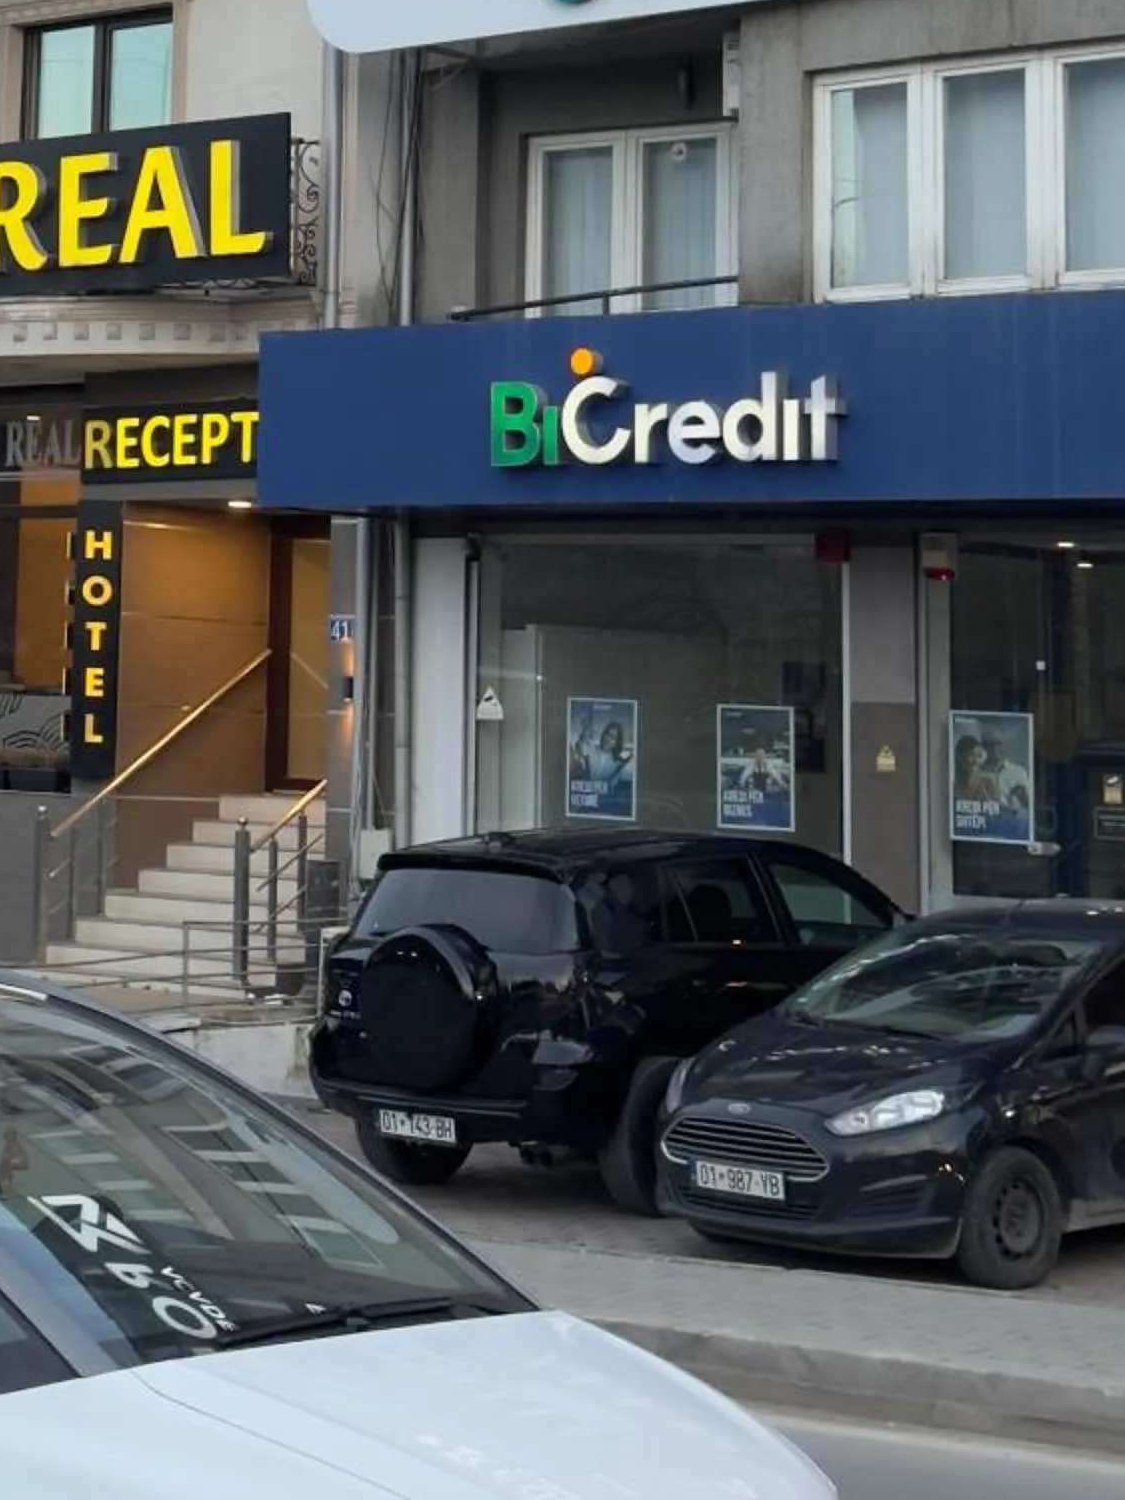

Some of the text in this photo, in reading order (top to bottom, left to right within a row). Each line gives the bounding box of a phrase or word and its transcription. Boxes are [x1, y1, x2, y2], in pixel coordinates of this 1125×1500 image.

[5, 408, 81, 468] REAL
[490, 348, 847, 466] BiCredit
[81, 529, 113, 744] HOTEL
